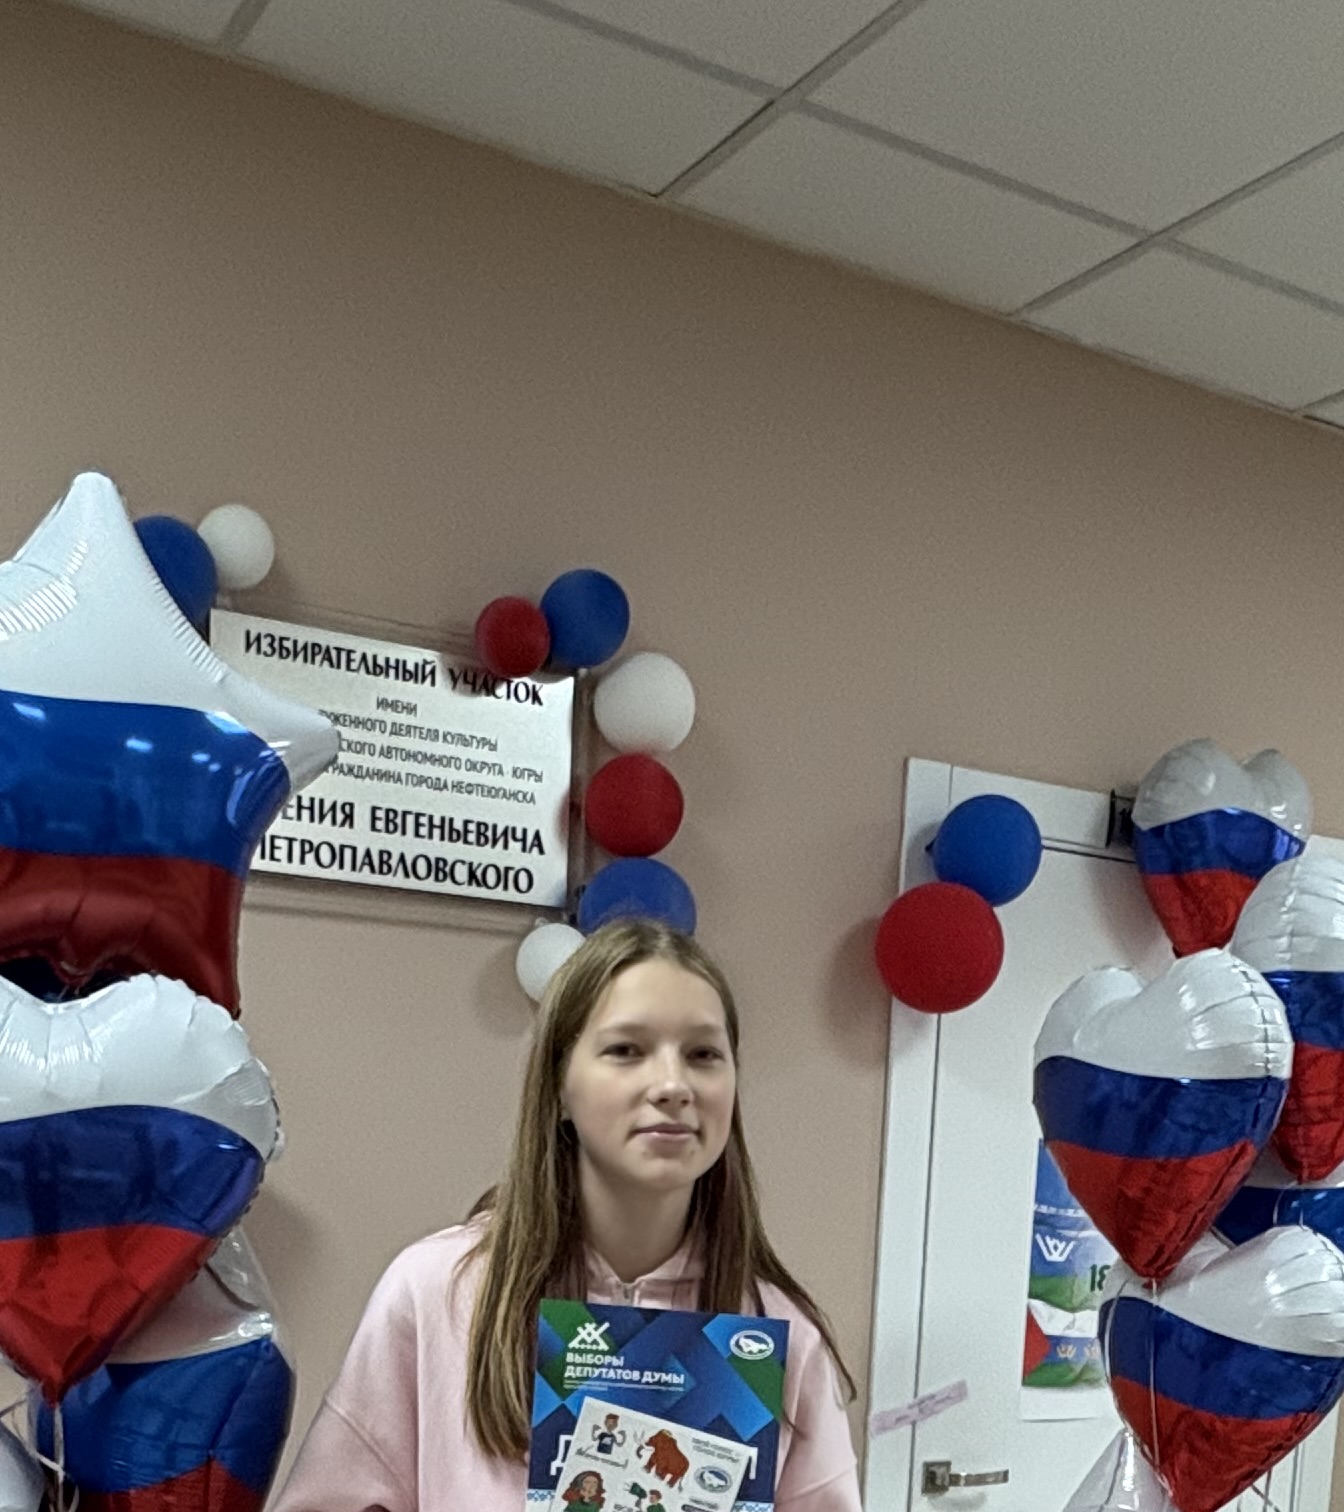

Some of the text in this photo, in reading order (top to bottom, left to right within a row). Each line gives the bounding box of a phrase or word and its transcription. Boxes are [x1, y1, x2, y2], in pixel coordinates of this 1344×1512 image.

[245, 629, 544, 706] ИЗБИРАТЕЛЬНЫЙ УЧАСТОК
[376, 696, 418, 717] ИМЕНИ
[319, 708, 498, 752] ЖЕННОГО ДЕЯТЕЛЯ КУЛЬТУРЫ
[339, 737, 544, 783] СКОГО АВТОНОМНОГО ОКРУГА ЮГРЫ
[325, 761, 537, 806] РАЖДАНИНА ГОРОДА НЕФТЕЮГАНСКА
[281, 795, 546, 856] ЕНИЯ ЕВГЕНЬЕВИЧА
[564, 1365, 685, 1384] ДЕПУТАТОВ ДУМЫ
[565, 1352, 624, 1367] ВЫБОРЫ
